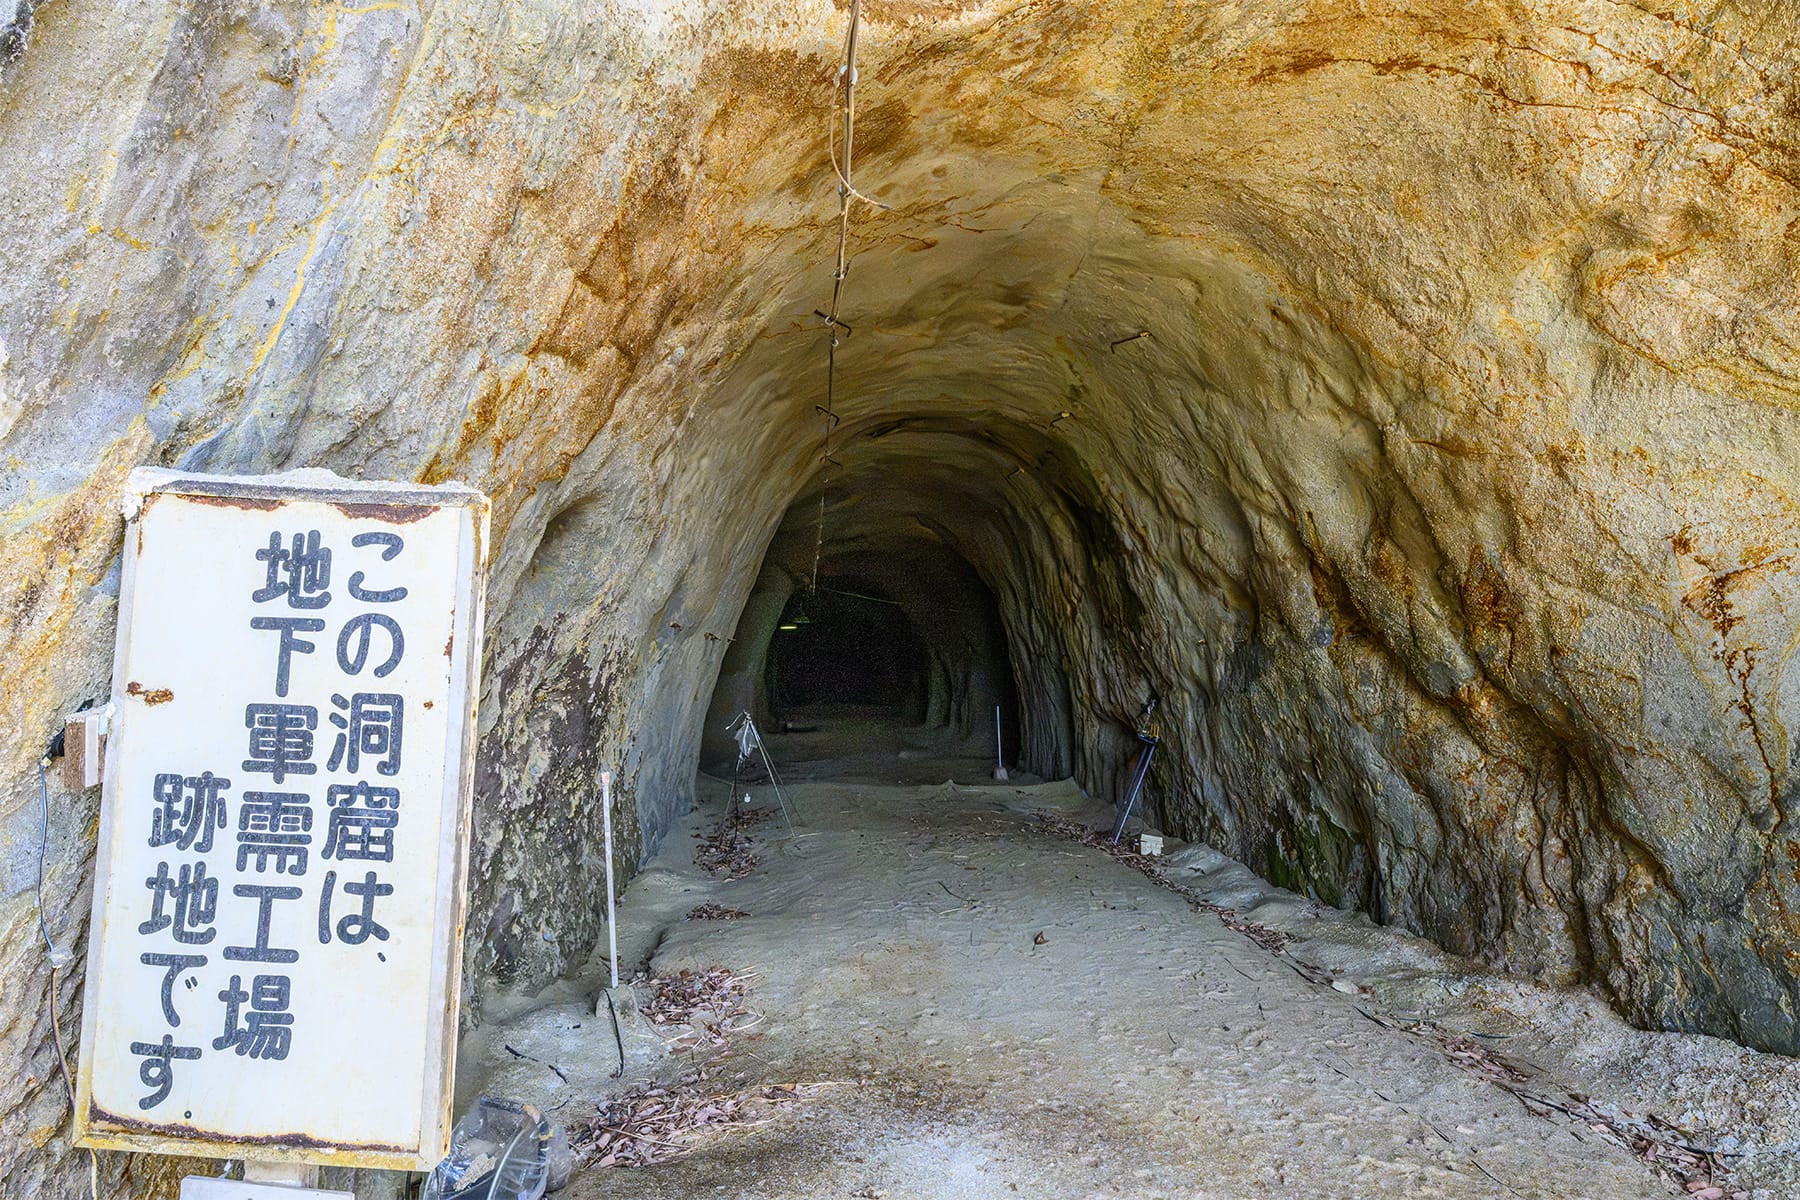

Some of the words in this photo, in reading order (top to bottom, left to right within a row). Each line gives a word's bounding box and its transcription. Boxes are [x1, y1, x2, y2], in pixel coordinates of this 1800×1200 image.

[211, 529, 332, 1061] 地下軍需工場
